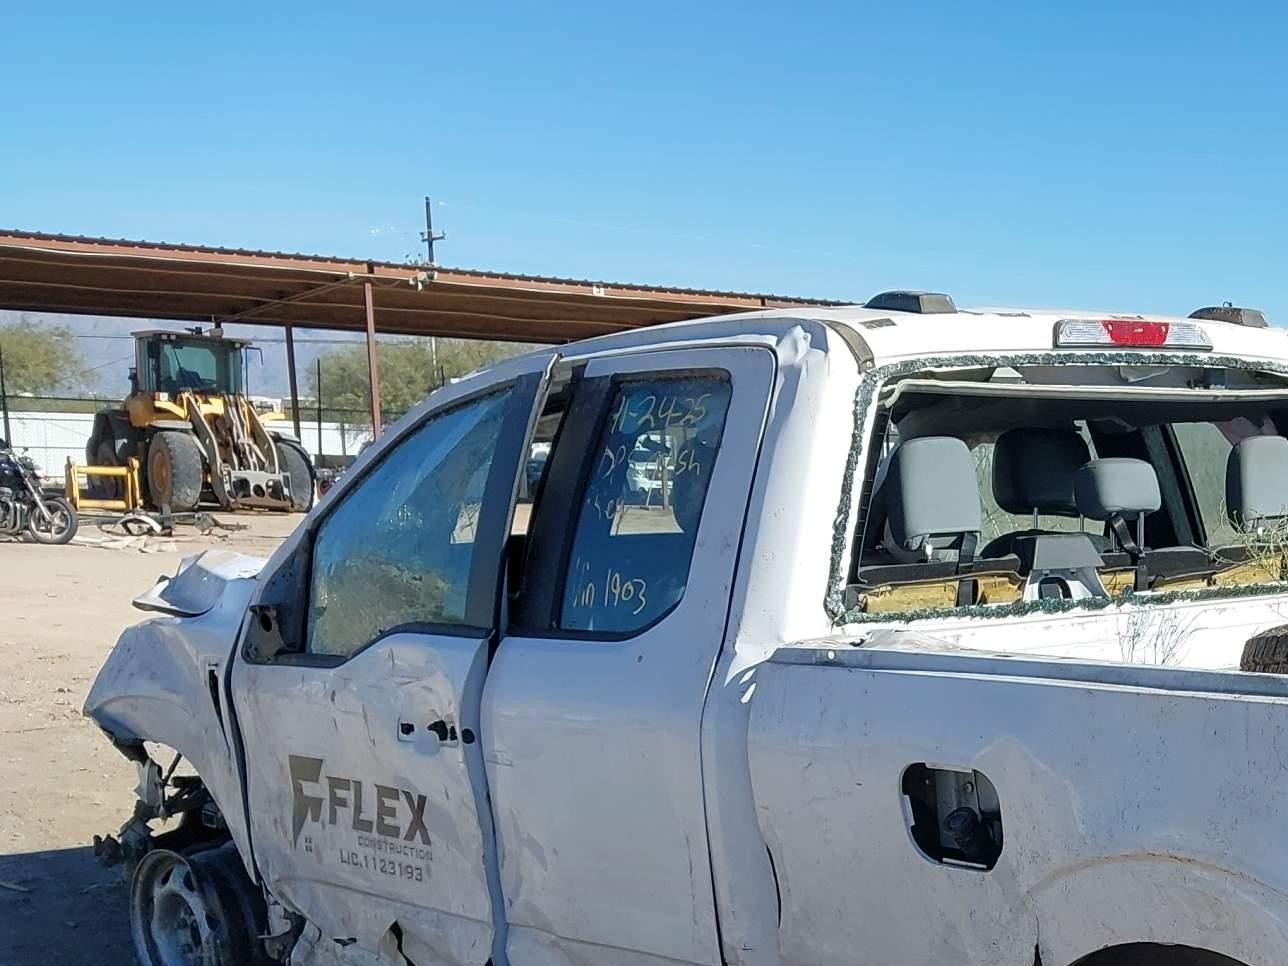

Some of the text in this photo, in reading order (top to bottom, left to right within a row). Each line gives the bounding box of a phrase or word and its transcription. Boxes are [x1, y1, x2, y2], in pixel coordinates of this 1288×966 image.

[605, 568, 647, 616] 1903
[326, 776, 432, 846] FLEX
[357, 835, 433, 862] CONSTRUCTION
